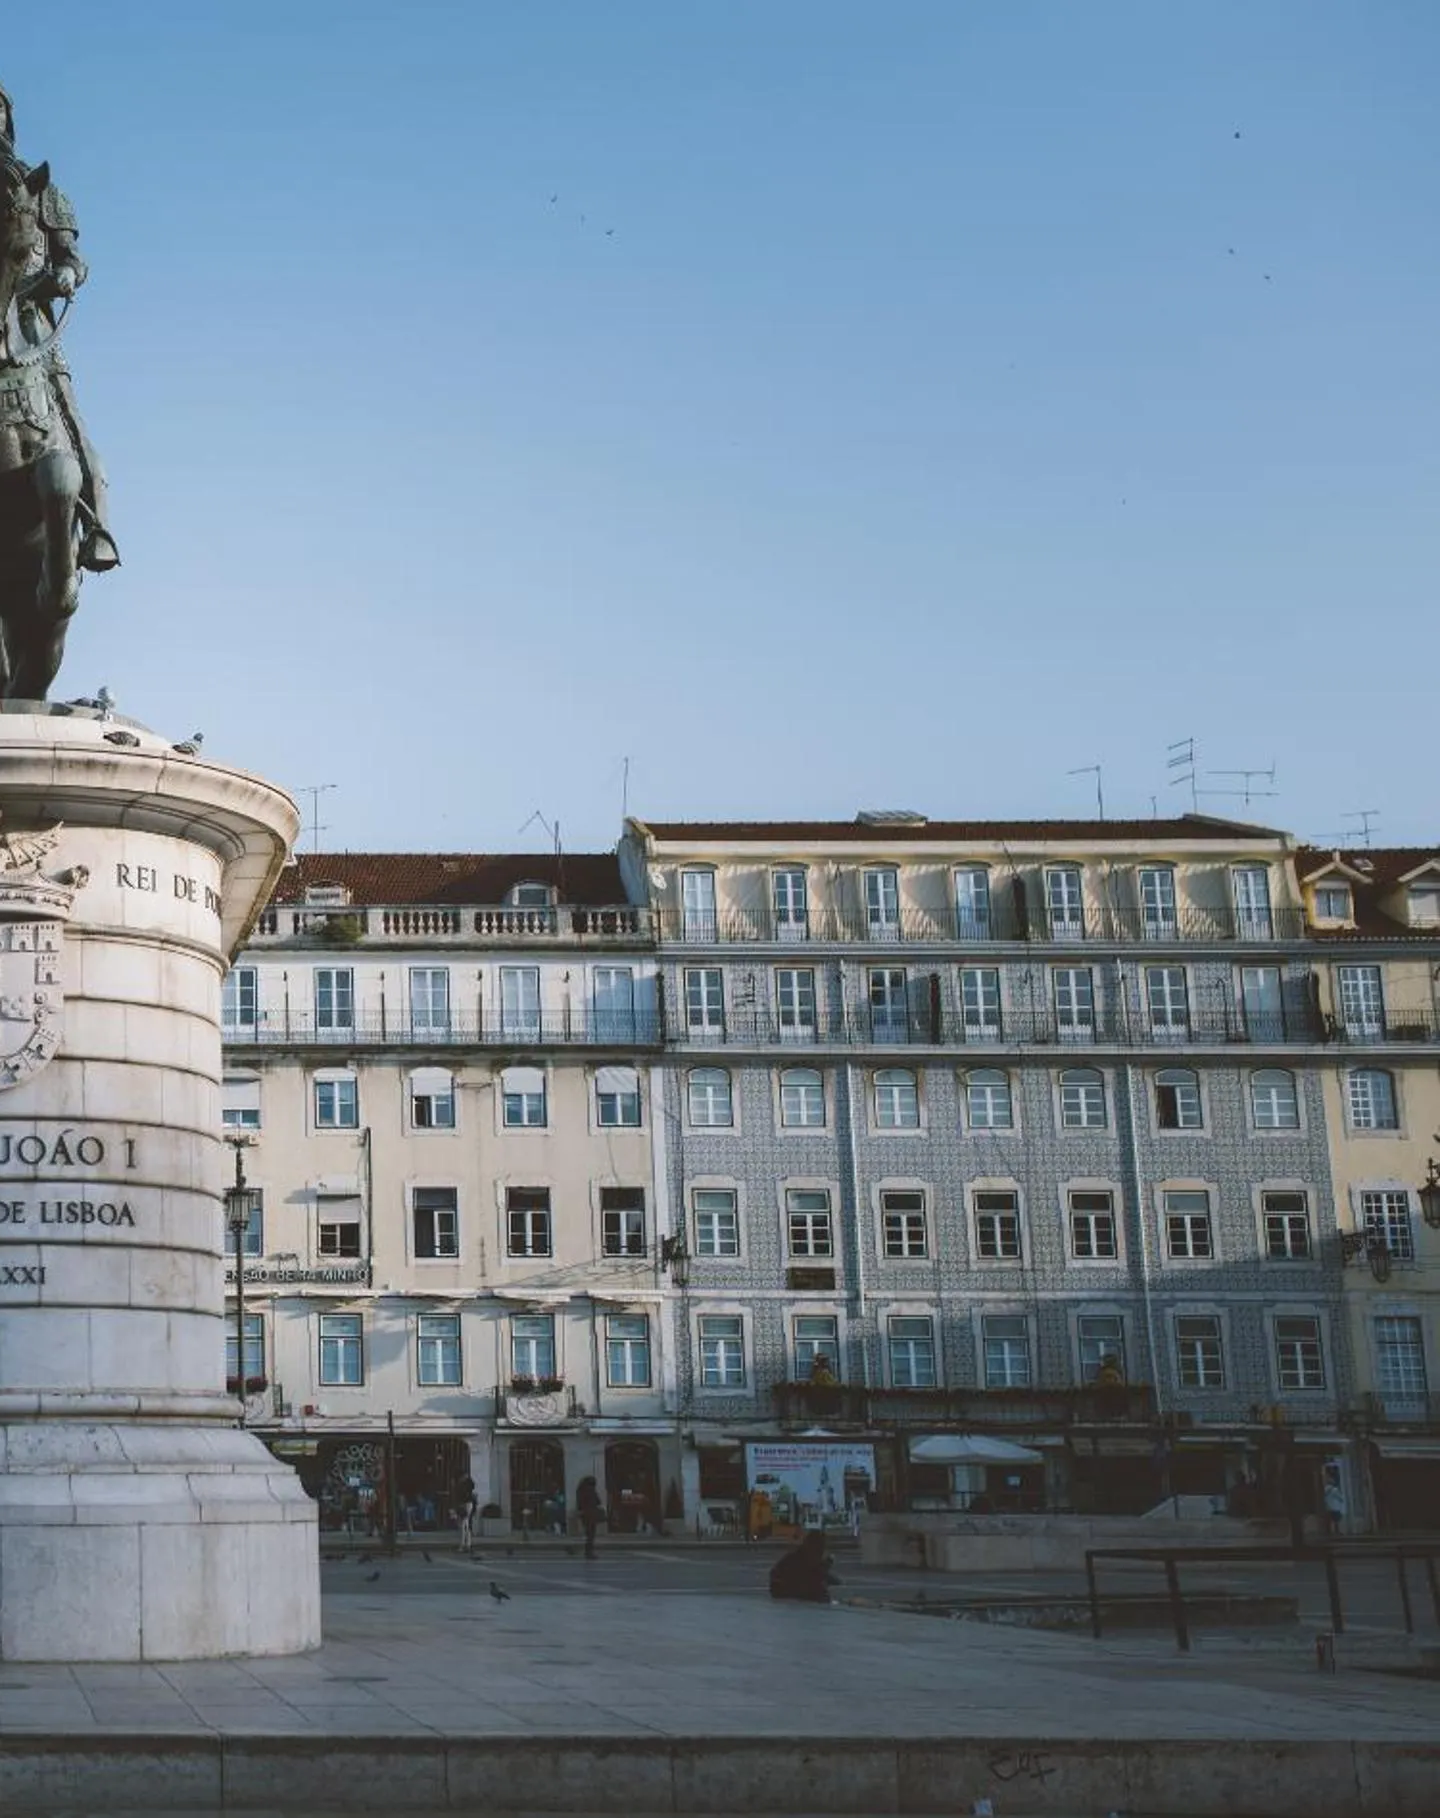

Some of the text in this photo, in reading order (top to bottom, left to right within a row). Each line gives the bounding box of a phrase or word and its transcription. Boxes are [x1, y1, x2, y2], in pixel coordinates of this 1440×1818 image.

[116, 863, 157, 892] REI
[174, 874, 197, 903] DE
[40, 1201, 137, 1228] LISBOA
